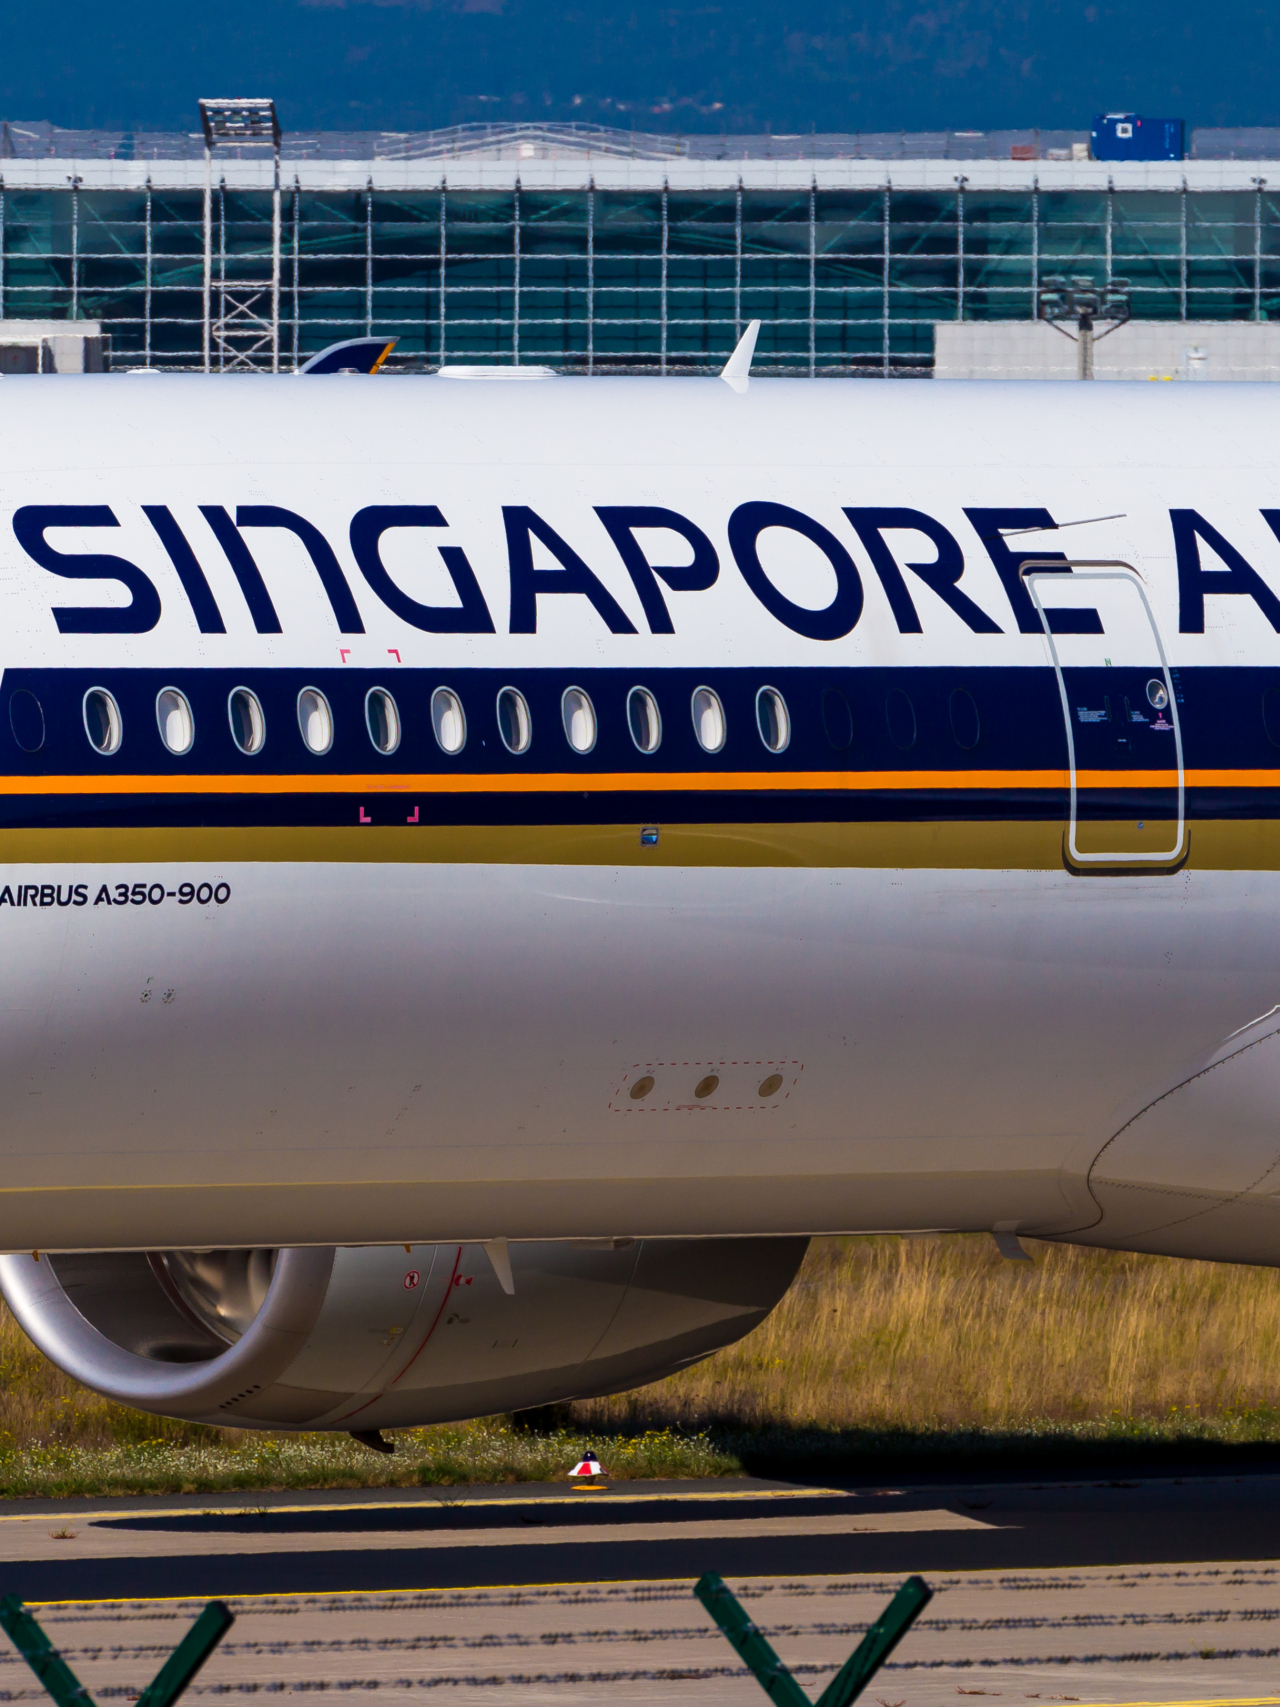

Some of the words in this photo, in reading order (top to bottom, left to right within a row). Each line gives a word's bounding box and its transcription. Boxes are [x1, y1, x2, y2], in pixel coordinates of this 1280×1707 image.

[12, 500, 1105, 641] SINGAPORE
[1168, 507, 1280, 635] A
[93, 882, 231, 906] A350-900
